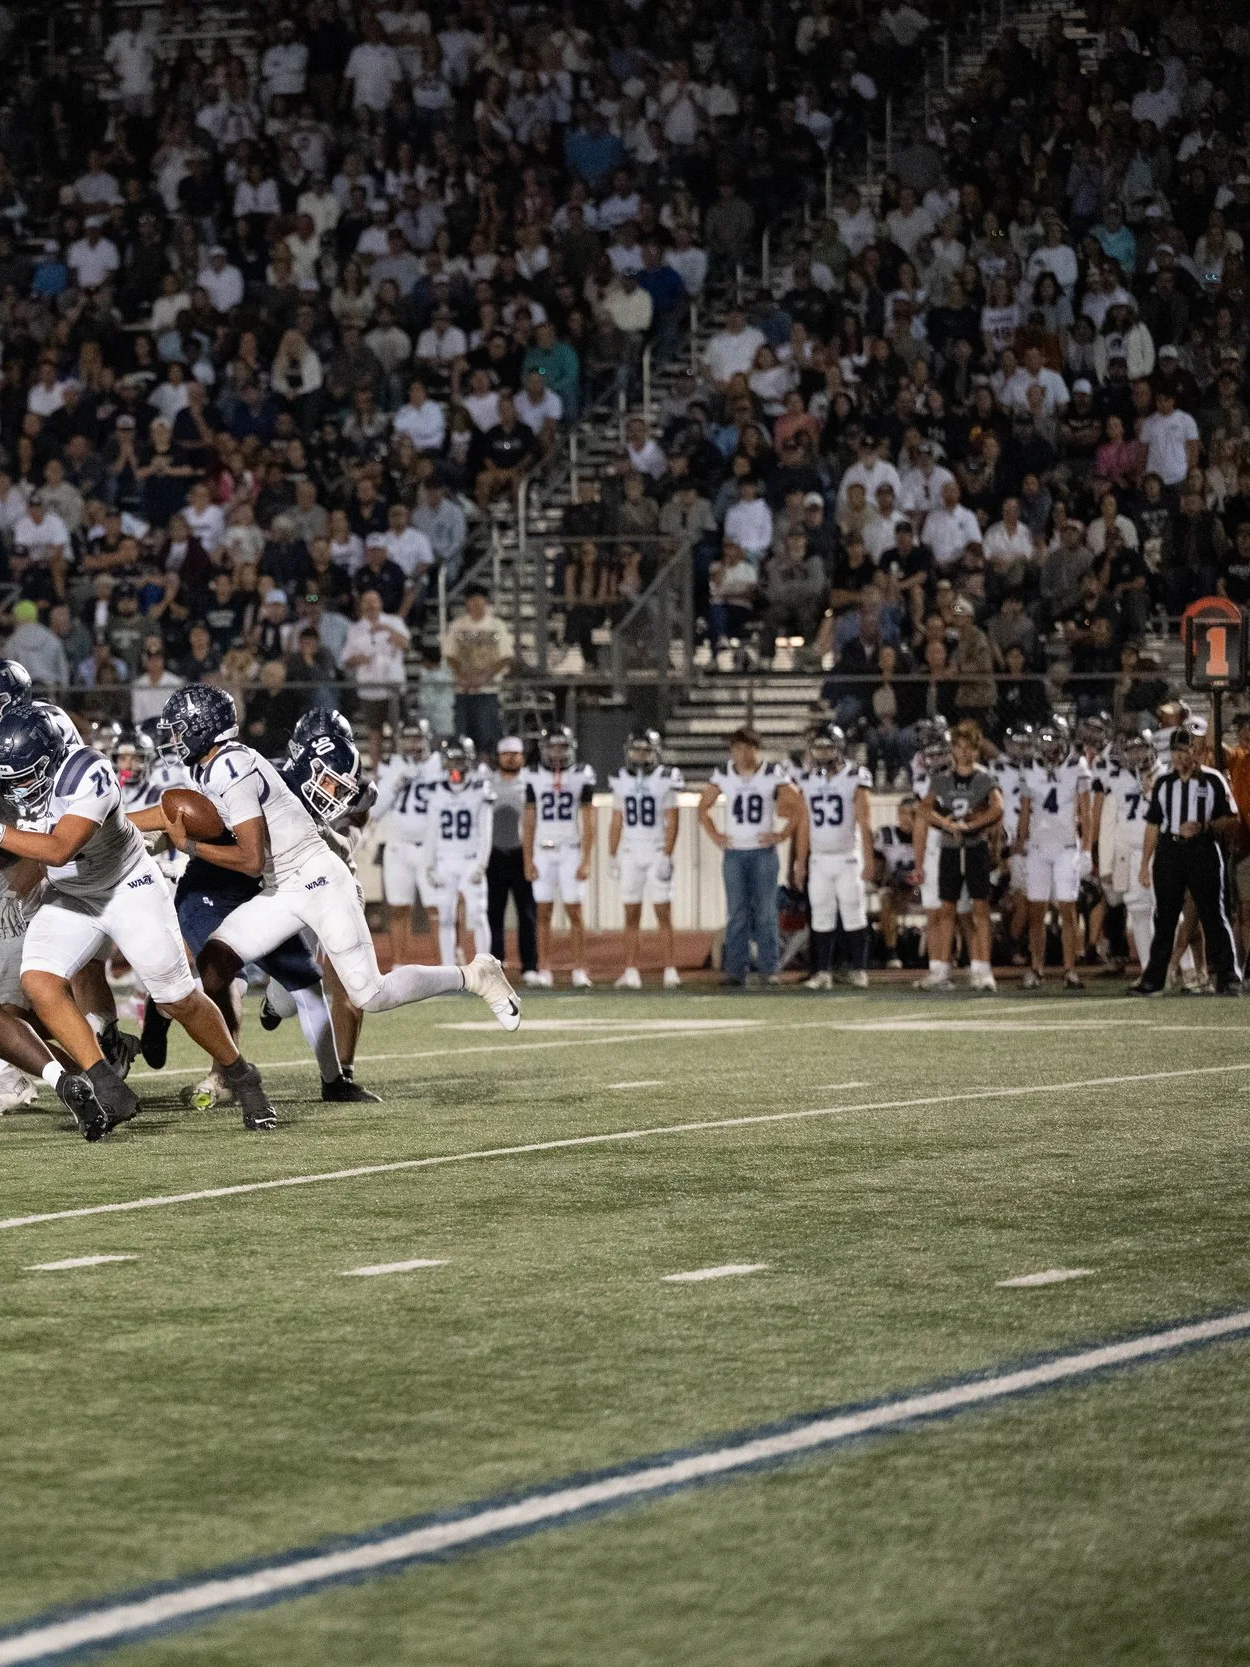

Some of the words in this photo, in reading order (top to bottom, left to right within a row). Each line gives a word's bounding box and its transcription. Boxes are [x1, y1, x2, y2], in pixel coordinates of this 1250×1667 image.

[1206, 627, 1229, 676] 1
[311, 736, 336, 755] 90
[223, 757, 239, 779] 1
[541, 792, 573, 821] 22
[626, 796, 655, 826] 88
[732, 794, 763, 824] 48
[810, 794, 844, 827] 53
[1043, 787, 1059, 813] 4
[440, 810, 472, 840] 28
